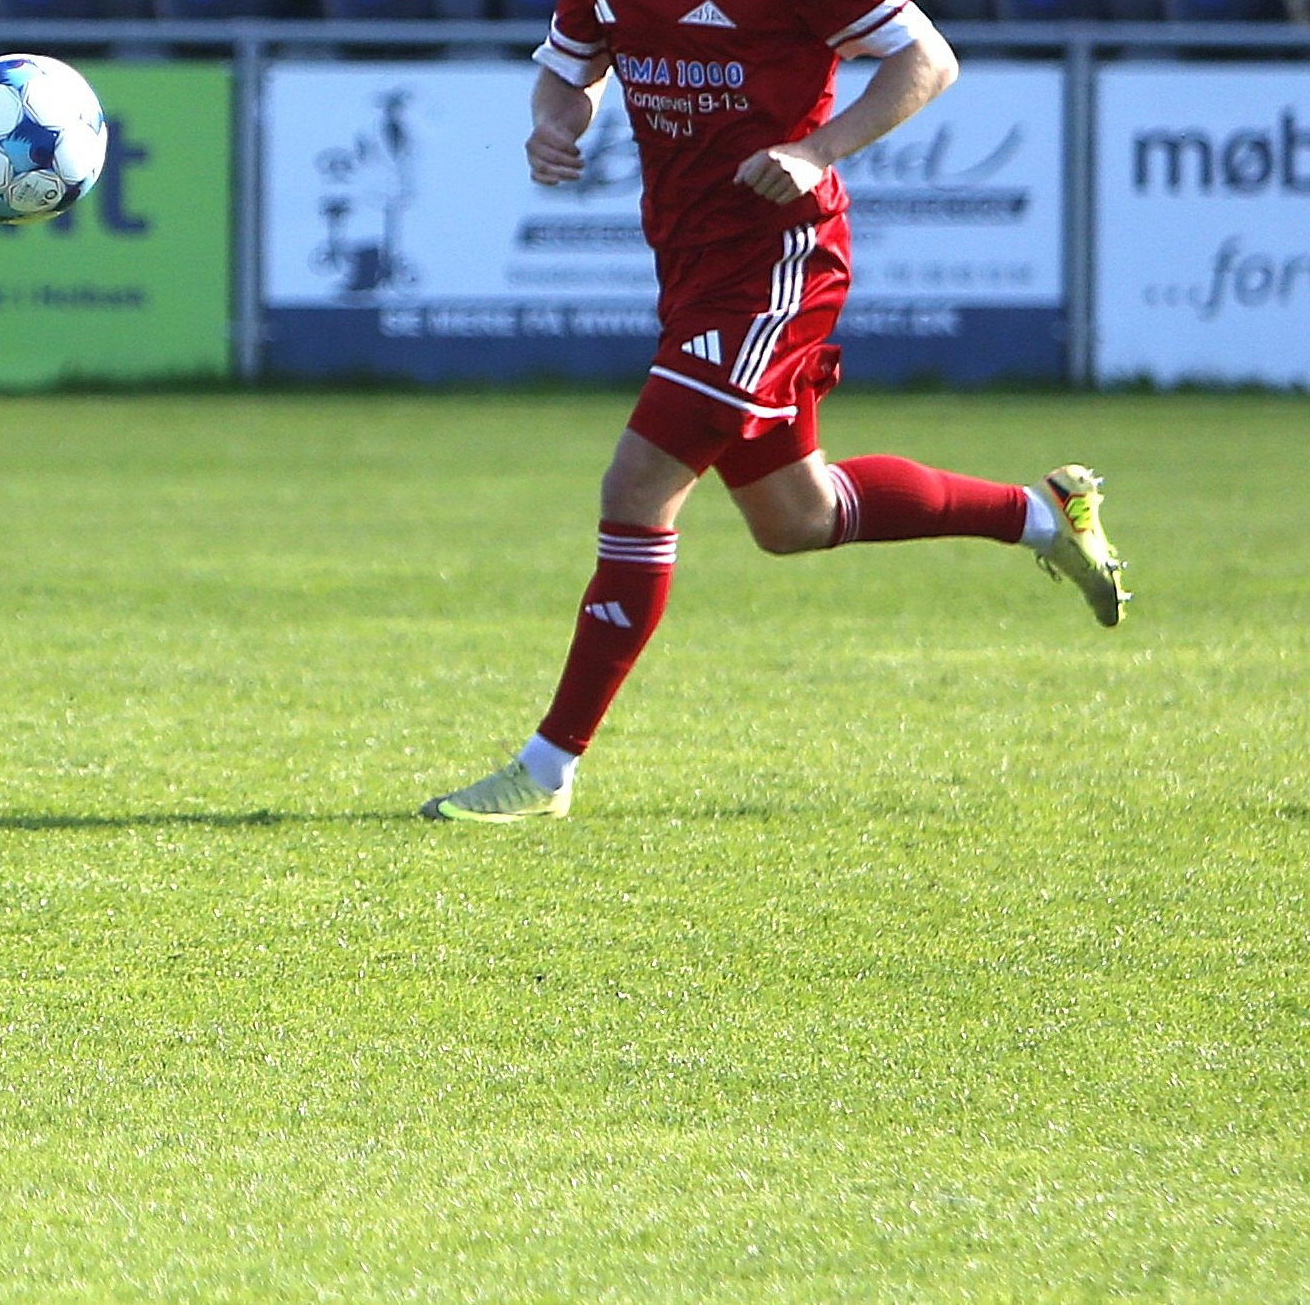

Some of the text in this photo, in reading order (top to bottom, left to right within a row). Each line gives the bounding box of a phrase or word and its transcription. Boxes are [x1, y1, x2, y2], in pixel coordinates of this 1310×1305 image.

[616, 53, 744, 89] EMA 1000
[698, 93, 750, 115] 9-13
[646, 114, 694, 139] Viby J
